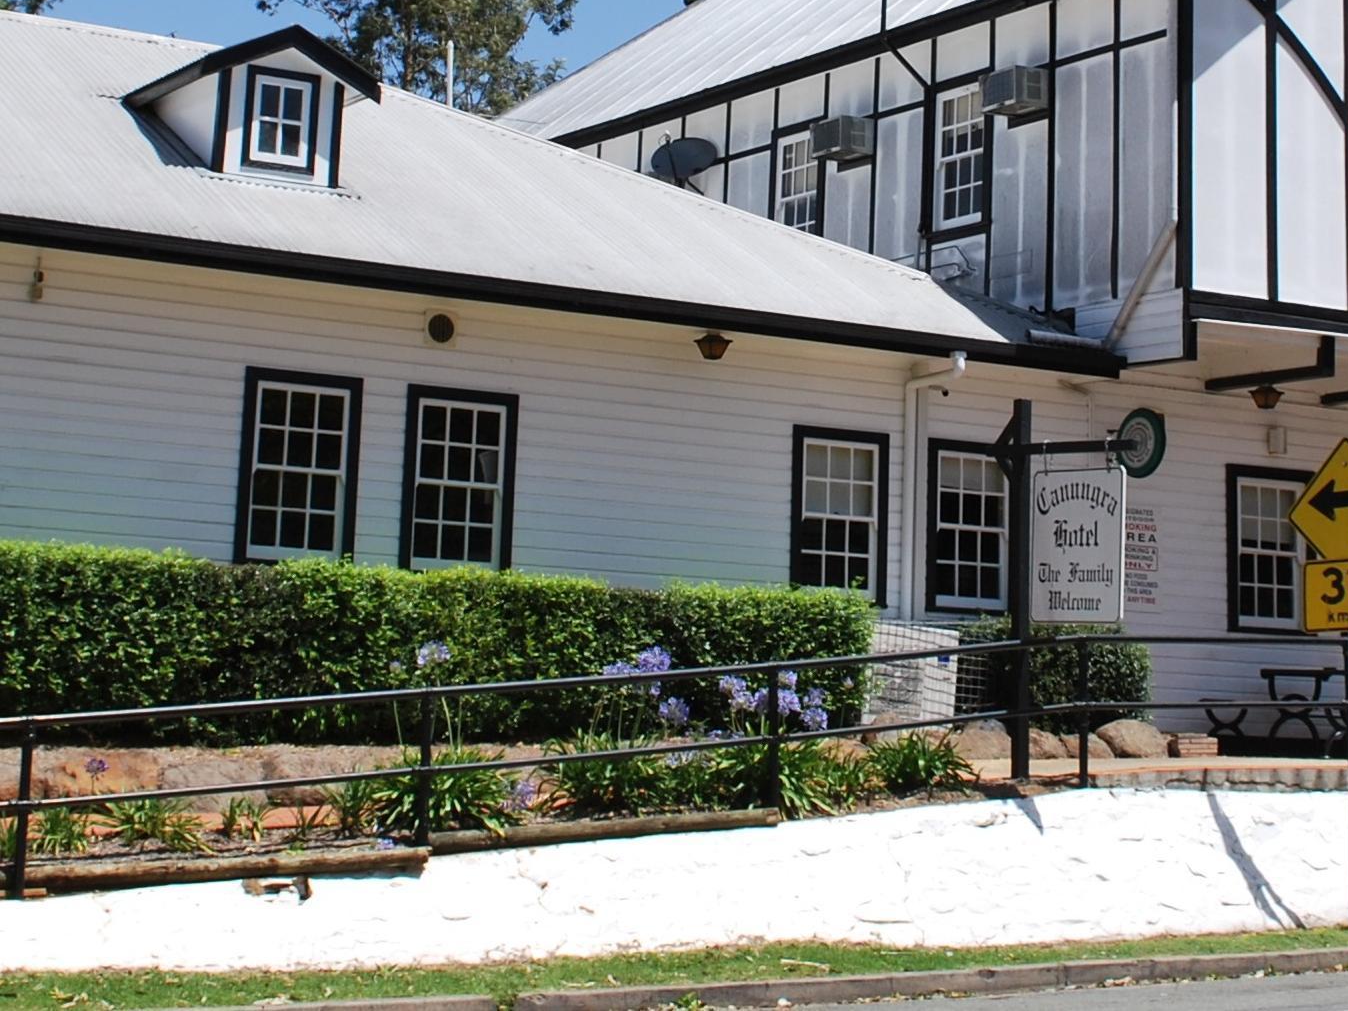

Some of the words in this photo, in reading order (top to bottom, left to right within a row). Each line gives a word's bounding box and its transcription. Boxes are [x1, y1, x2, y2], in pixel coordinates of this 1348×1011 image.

[1036, 482, 1118, 516] Canungra
[1053, 519, 1099, 554] Hotel
[1126, 532, 1157, 543] REA
[1038, 562, 1061, 584] The
[1067, 562, 1114, 587] Family
[1048, 590, 1101, 611] Welcome
